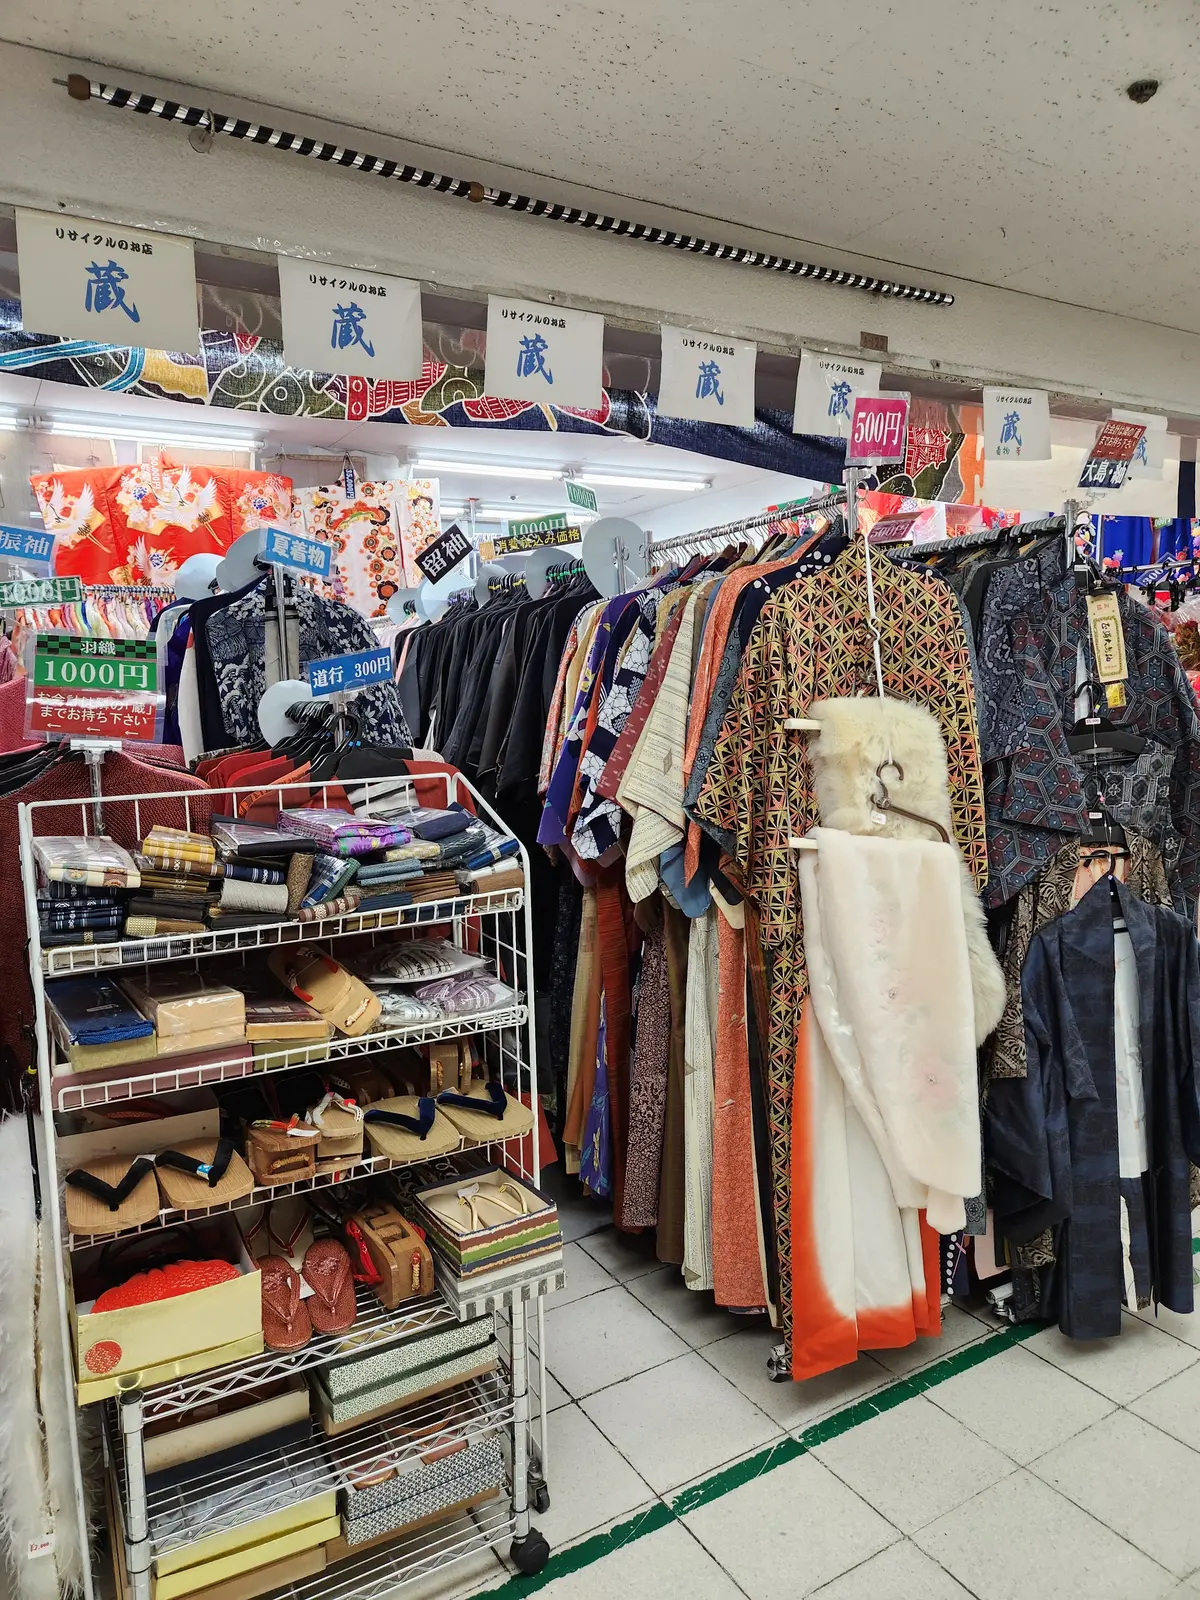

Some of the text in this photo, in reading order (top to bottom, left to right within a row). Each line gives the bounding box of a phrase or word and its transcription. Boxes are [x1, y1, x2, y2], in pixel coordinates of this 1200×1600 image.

[55, 227, 153, 255] リサイクルのお店
[84, 259, 140, 323] 蔵
[309, 274, 387, 297] リサイクルのお店
[331, 302, 375, 357] 蔵
[501, 309, 566, 329] リサイクルのお店
[516, 333, 553, 385] 蔵
[681, 338, 735, 356] リサイクルのお店
[695, 359, 724, 405] 蔵
[820, 361, 865, 376] リサイクルのお店
[828, 380, 852, 420] 蔵
[995, 395, 1032, 405] リサイクルのお店
[854, 411, 902, 446] 500円
[1000, 410, 1022, 447] 蔵
[1080, 459, 1127, 484] 大島・紬
[495, 530, 580, 554] 消費税込み価格
[871, 523, 909, 538] 500円
[272, 533, 325, 569] 夏着物
[421, 532, 468, 577] 留袖
[80, 641, 117, 656] 羽織
[44, 660, 148, 688] 1000円
[312, 655, 390, 689] 道行 300円
[40, 705, 147, 726] までお持ち下さい
